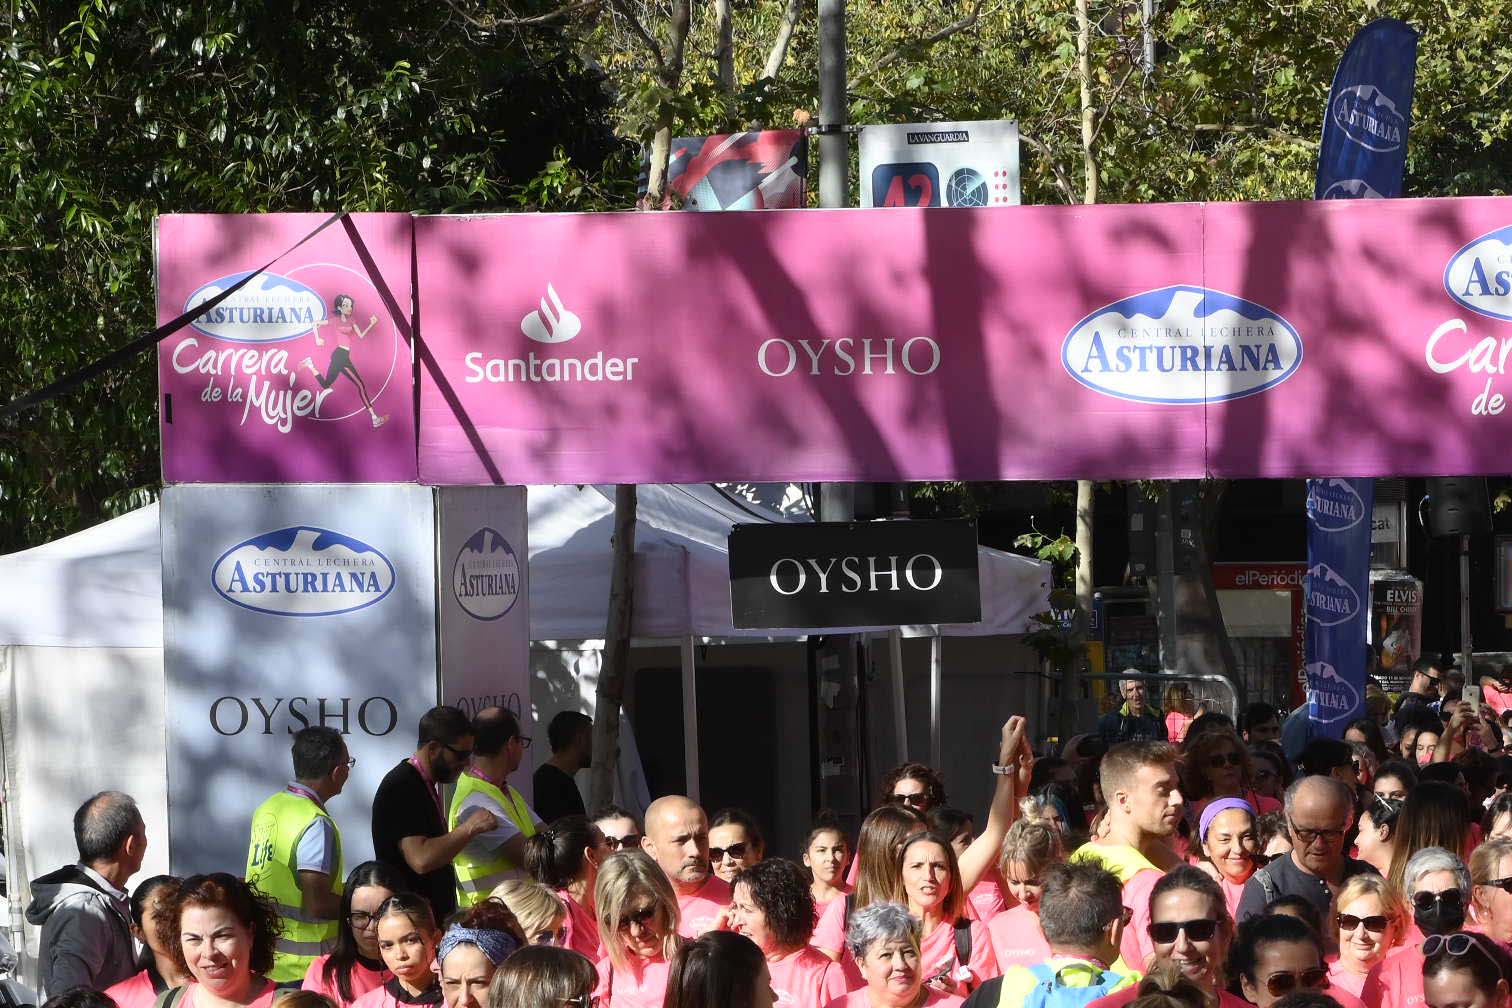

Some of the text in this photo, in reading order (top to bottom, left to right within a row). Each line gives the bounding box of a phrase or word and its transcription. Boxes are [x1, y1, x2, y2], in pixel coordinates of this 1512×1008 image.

[919, 132, 969, 143] VANGUARDIA
[195, 300, 315, 324] ASTURIANA
[1117, 327, 1192, 338] CENTRAL
[172, 337, 289, 376] Carrera
[465, 350, 640, 383] Santander
[757, 337, 941, 377] OYSHO
[1081, 330, 1283, 373] ASTURIANA
[202, 371, 333, 433] de la Mujer
[1471, 377, 1506, 416] de
[226, 560, 382, 594] ASTURIANA
[254, 558, 312, 567] CENTRAL
[770, 553, 943, 597] OYSHO
[1235, 567, 1306, 587] elPeriódi
[458, 566, 517, 598] ASTURIANA
[1386, 590, 1417, 602] ELVIS
[209, 696, 398, 736] OYSHO
